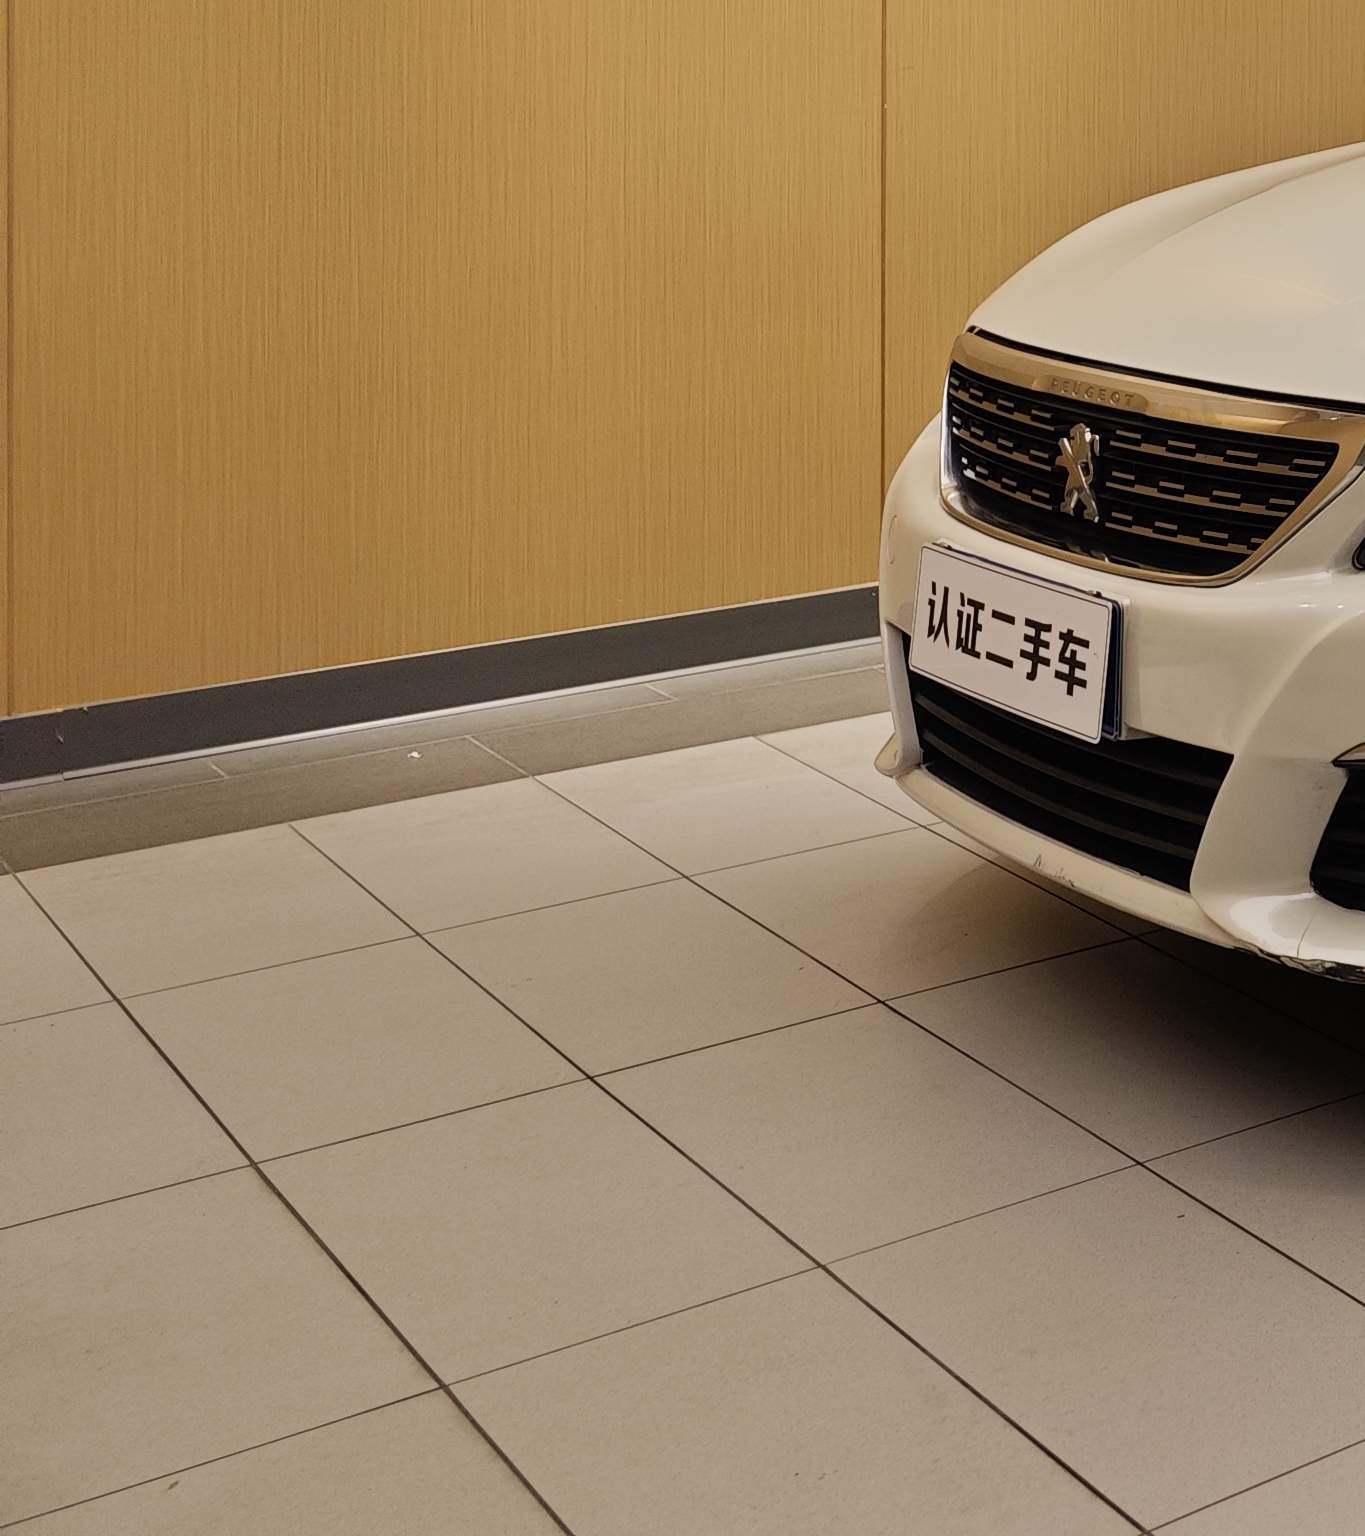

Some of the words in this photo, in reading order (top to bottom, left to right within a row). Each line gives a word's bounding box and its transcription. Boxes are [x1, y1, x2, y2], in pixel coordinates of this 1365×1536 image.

[1050, 378, 1134, 406] PEUGEOT
[926, 581, 1091, 697] 认证二手车
